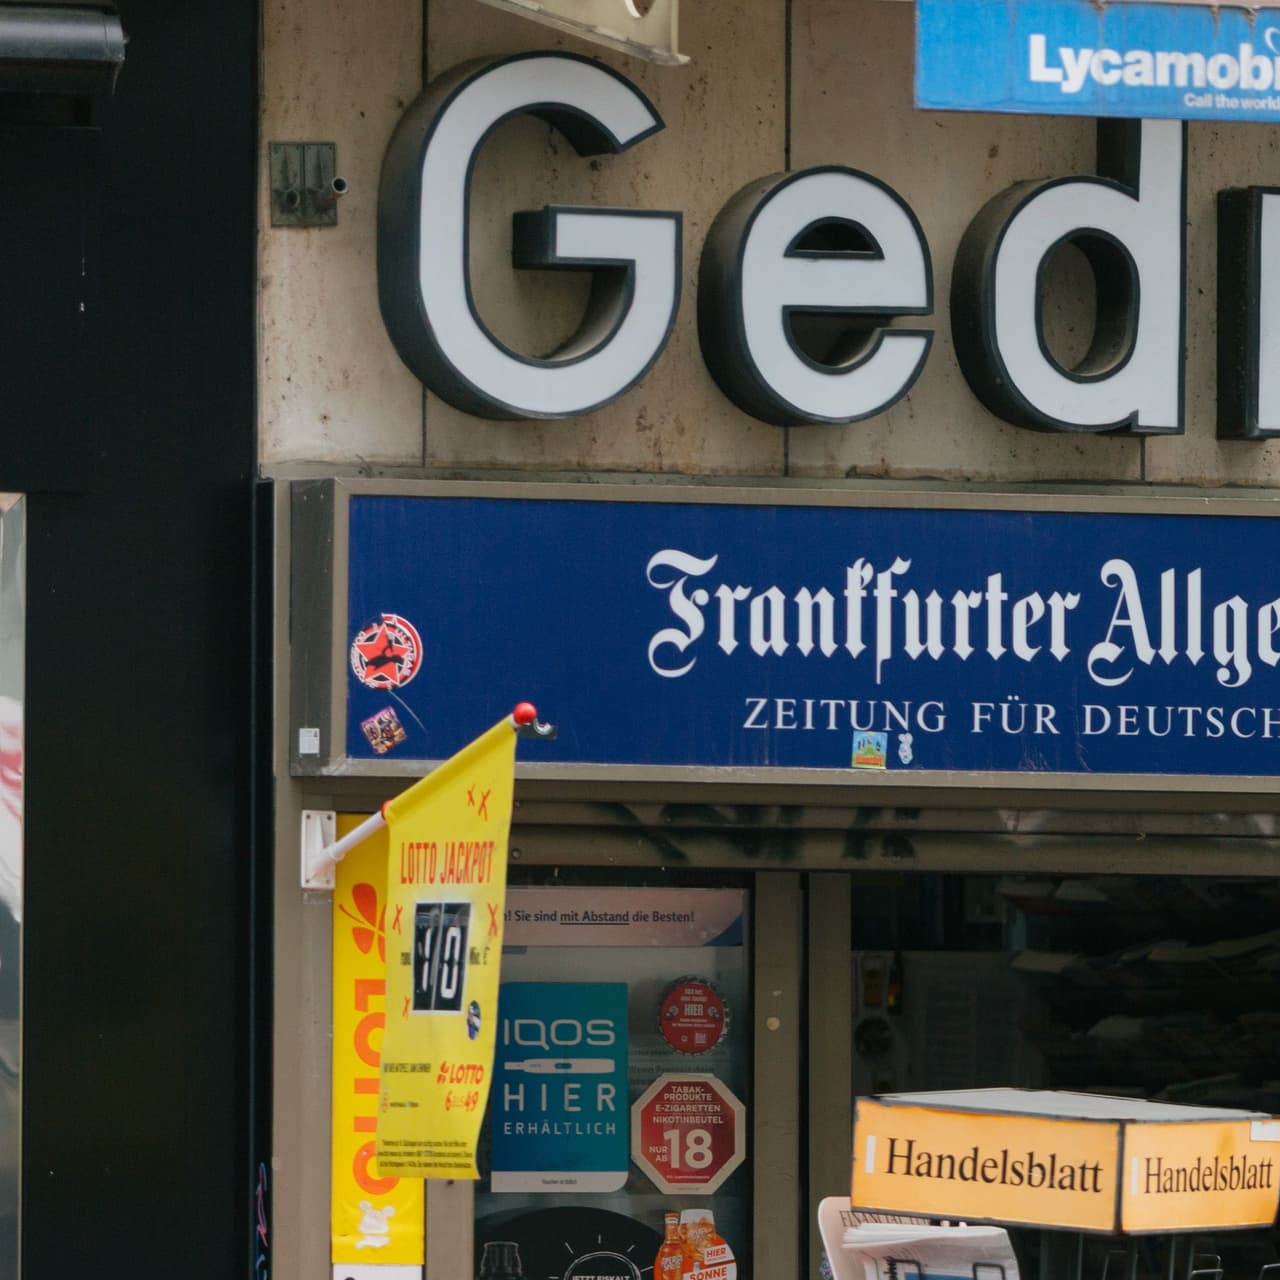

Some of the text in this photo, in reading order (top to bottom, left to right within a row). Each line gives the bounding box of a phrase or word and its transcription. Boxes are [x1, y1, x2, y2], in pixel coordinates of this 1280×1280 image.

[646, 548, 1083, 684] Frankfurter
[743, 696, 947, 734] ZEITUNG
[972, 694, 1061, 736] FÜR
[400, 840, 495, 885] LOTTO JACKPOT
[515, 910, 532, 922] Sie
[534, 910, 557, 922] sind
[560, 910, 579, 922] mit
[582, 910, 629, 922] Abstand
[631, 910, 649, 923] die
[652, 910, 695, 923] Besten!
[504, 1019, 616, 1050] IQOS
[447, 1063, 484, 1085] LOTTO
[504, 1083, 616, 1112] HIER
[655, 1104, 720, 1112] E-ZIGARETTEN
[664, 1093, 712, 1101] PRODUKTE
[504, 1120, 616, 1135] ERHÄLTLICH
[663, 1128, 713, 1169] 18
[886, 1137, 1104, 1194] Handelsblatt
[1144, 1153, 1274, 1195] Handelsblatt
[706, 1247, 726, 1258] HIER
